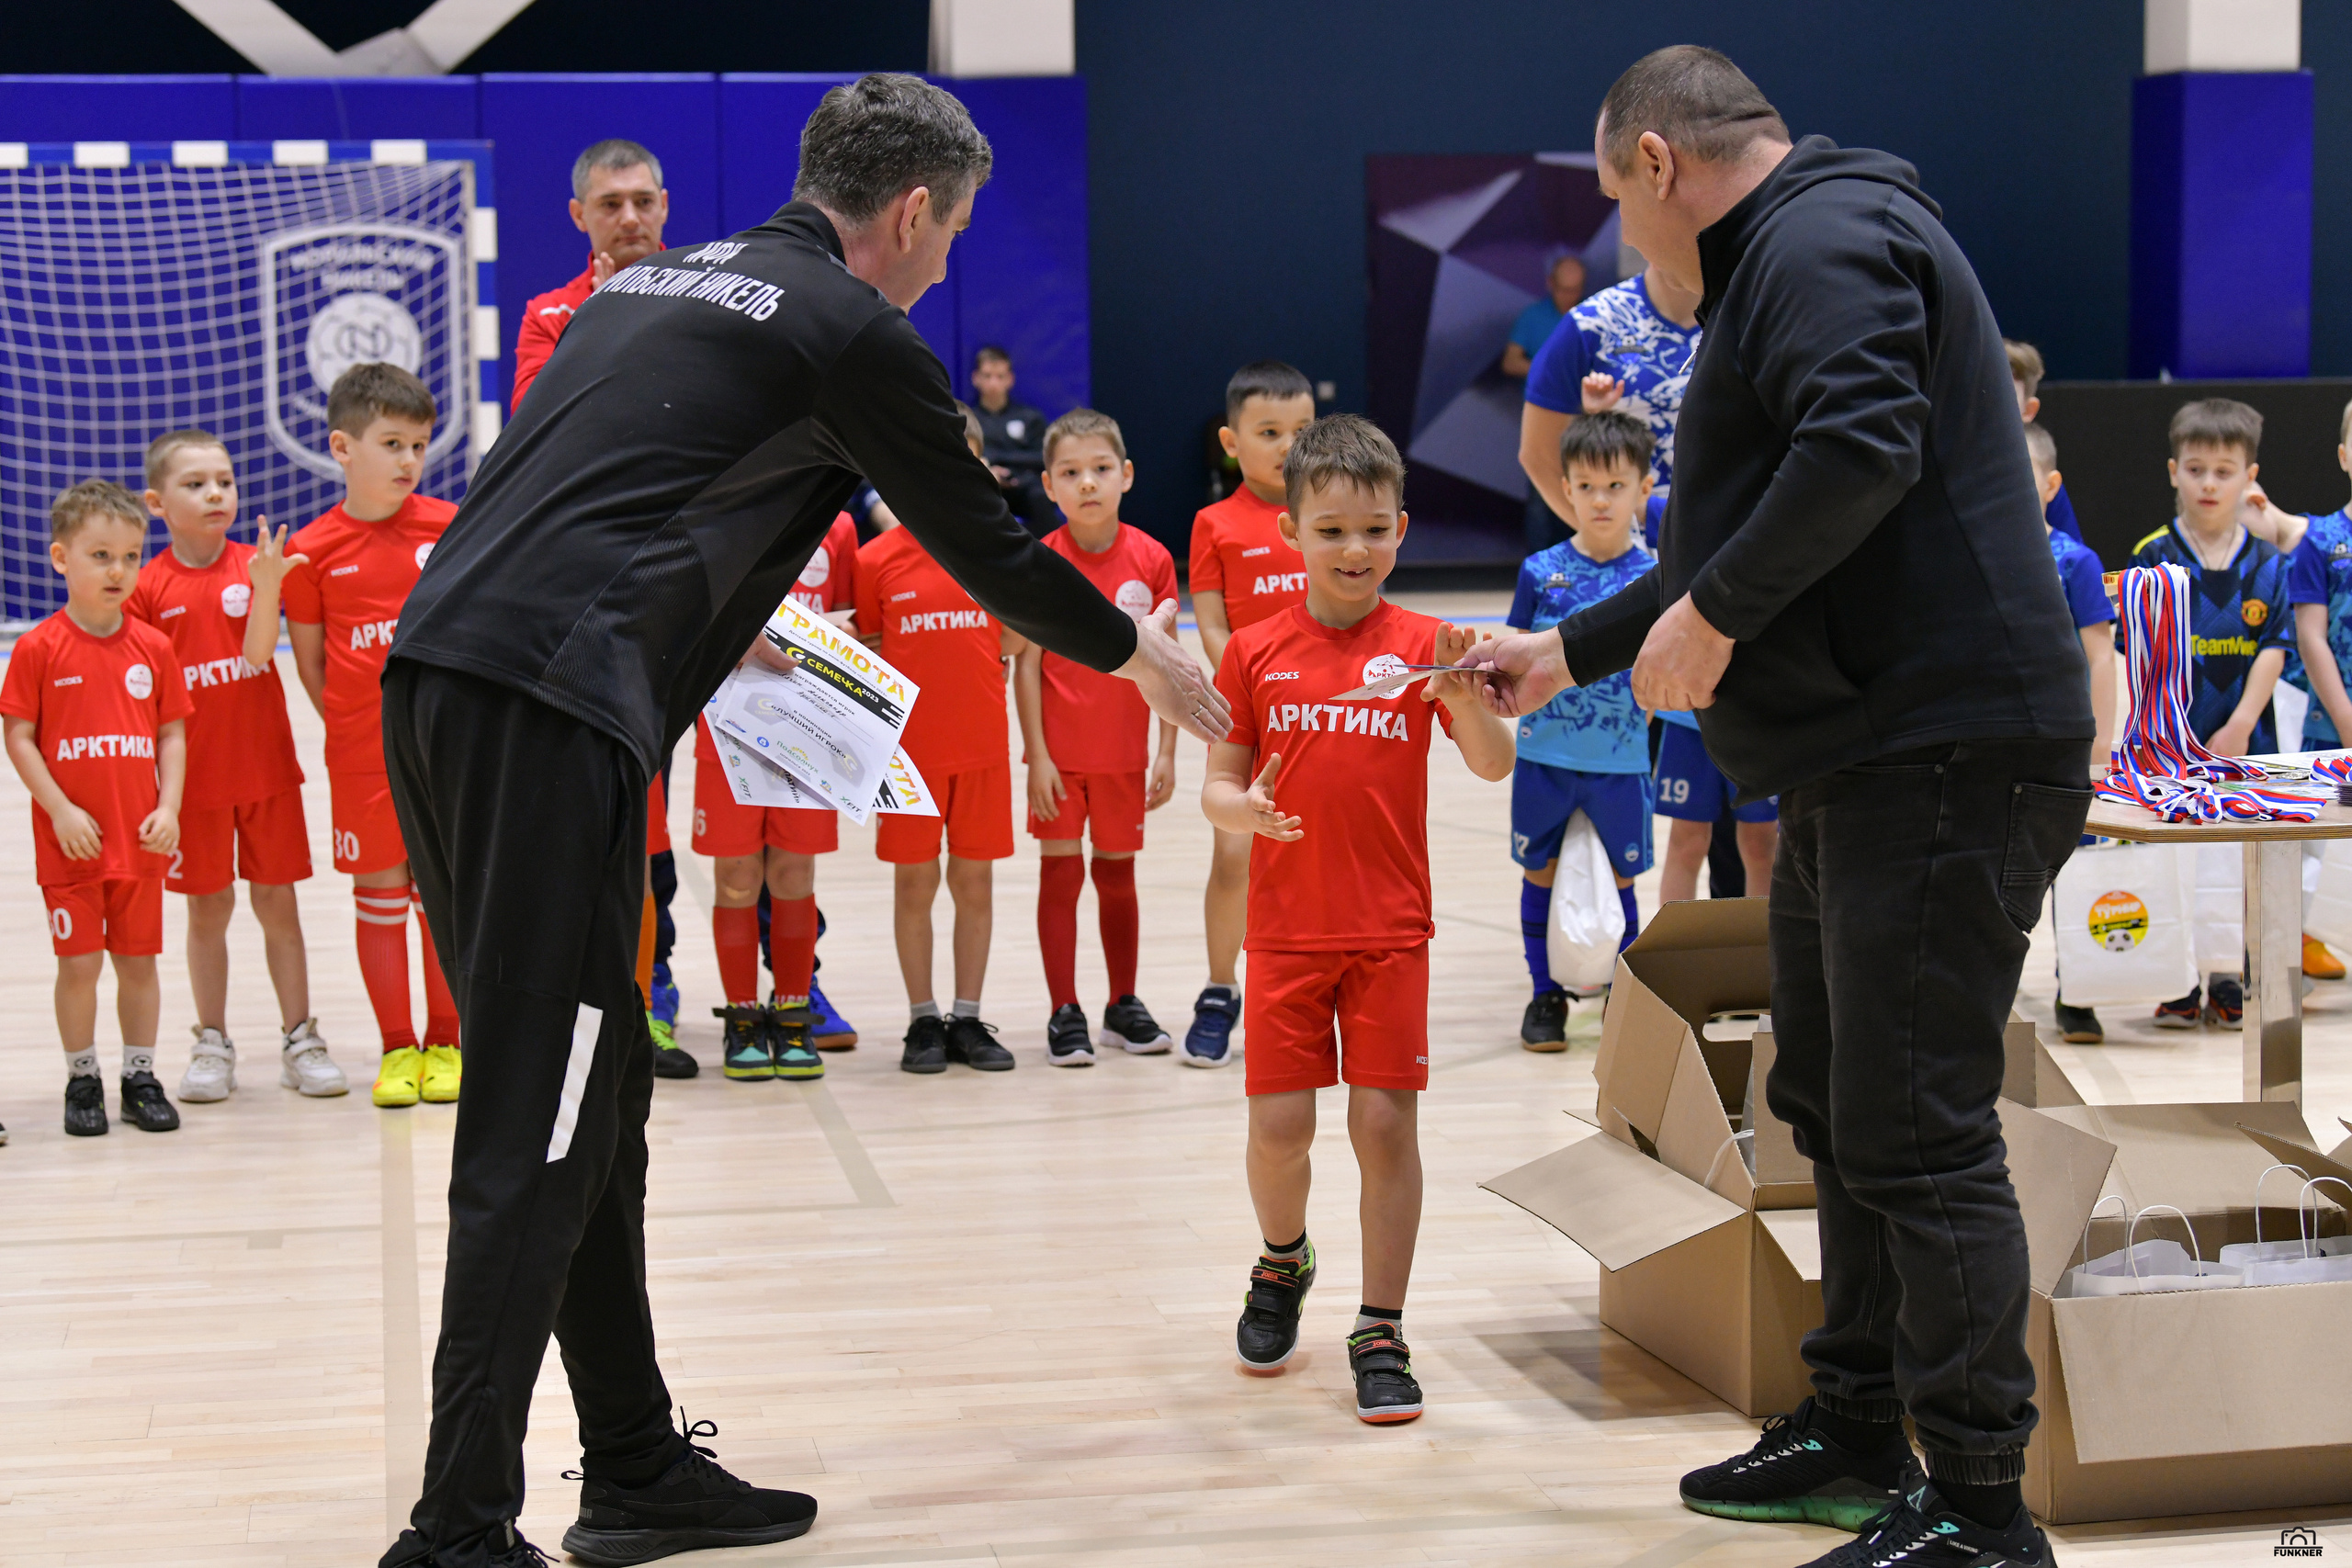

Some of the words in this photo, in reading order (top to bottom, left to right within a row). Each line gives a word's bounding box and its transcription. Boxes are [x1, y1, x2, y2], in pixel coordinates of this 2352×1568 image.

[687, 272, 786, 321] НИКЕЛЬ
[1253, 571, 1308, 595] АРКТ
[900, 610, 989, 635] АРКТИКА
[777, 602, 905, 704] ГРАМОТА
[807, 658, 863, 697] СЕМЕЧКА
[862, 687, 879, 703] 2023
[1264, 671, 1300, 682] KODES
[770, 703, 815, 734] «ЛУЧШИЙ
[813, 733, 848, 759] ИГРОК»
[1267, 704, 1408, 742] АРКТИКА
[57, 735, 155, 761] АРКТИКА
[1659, 778, 1690, 804] 19
